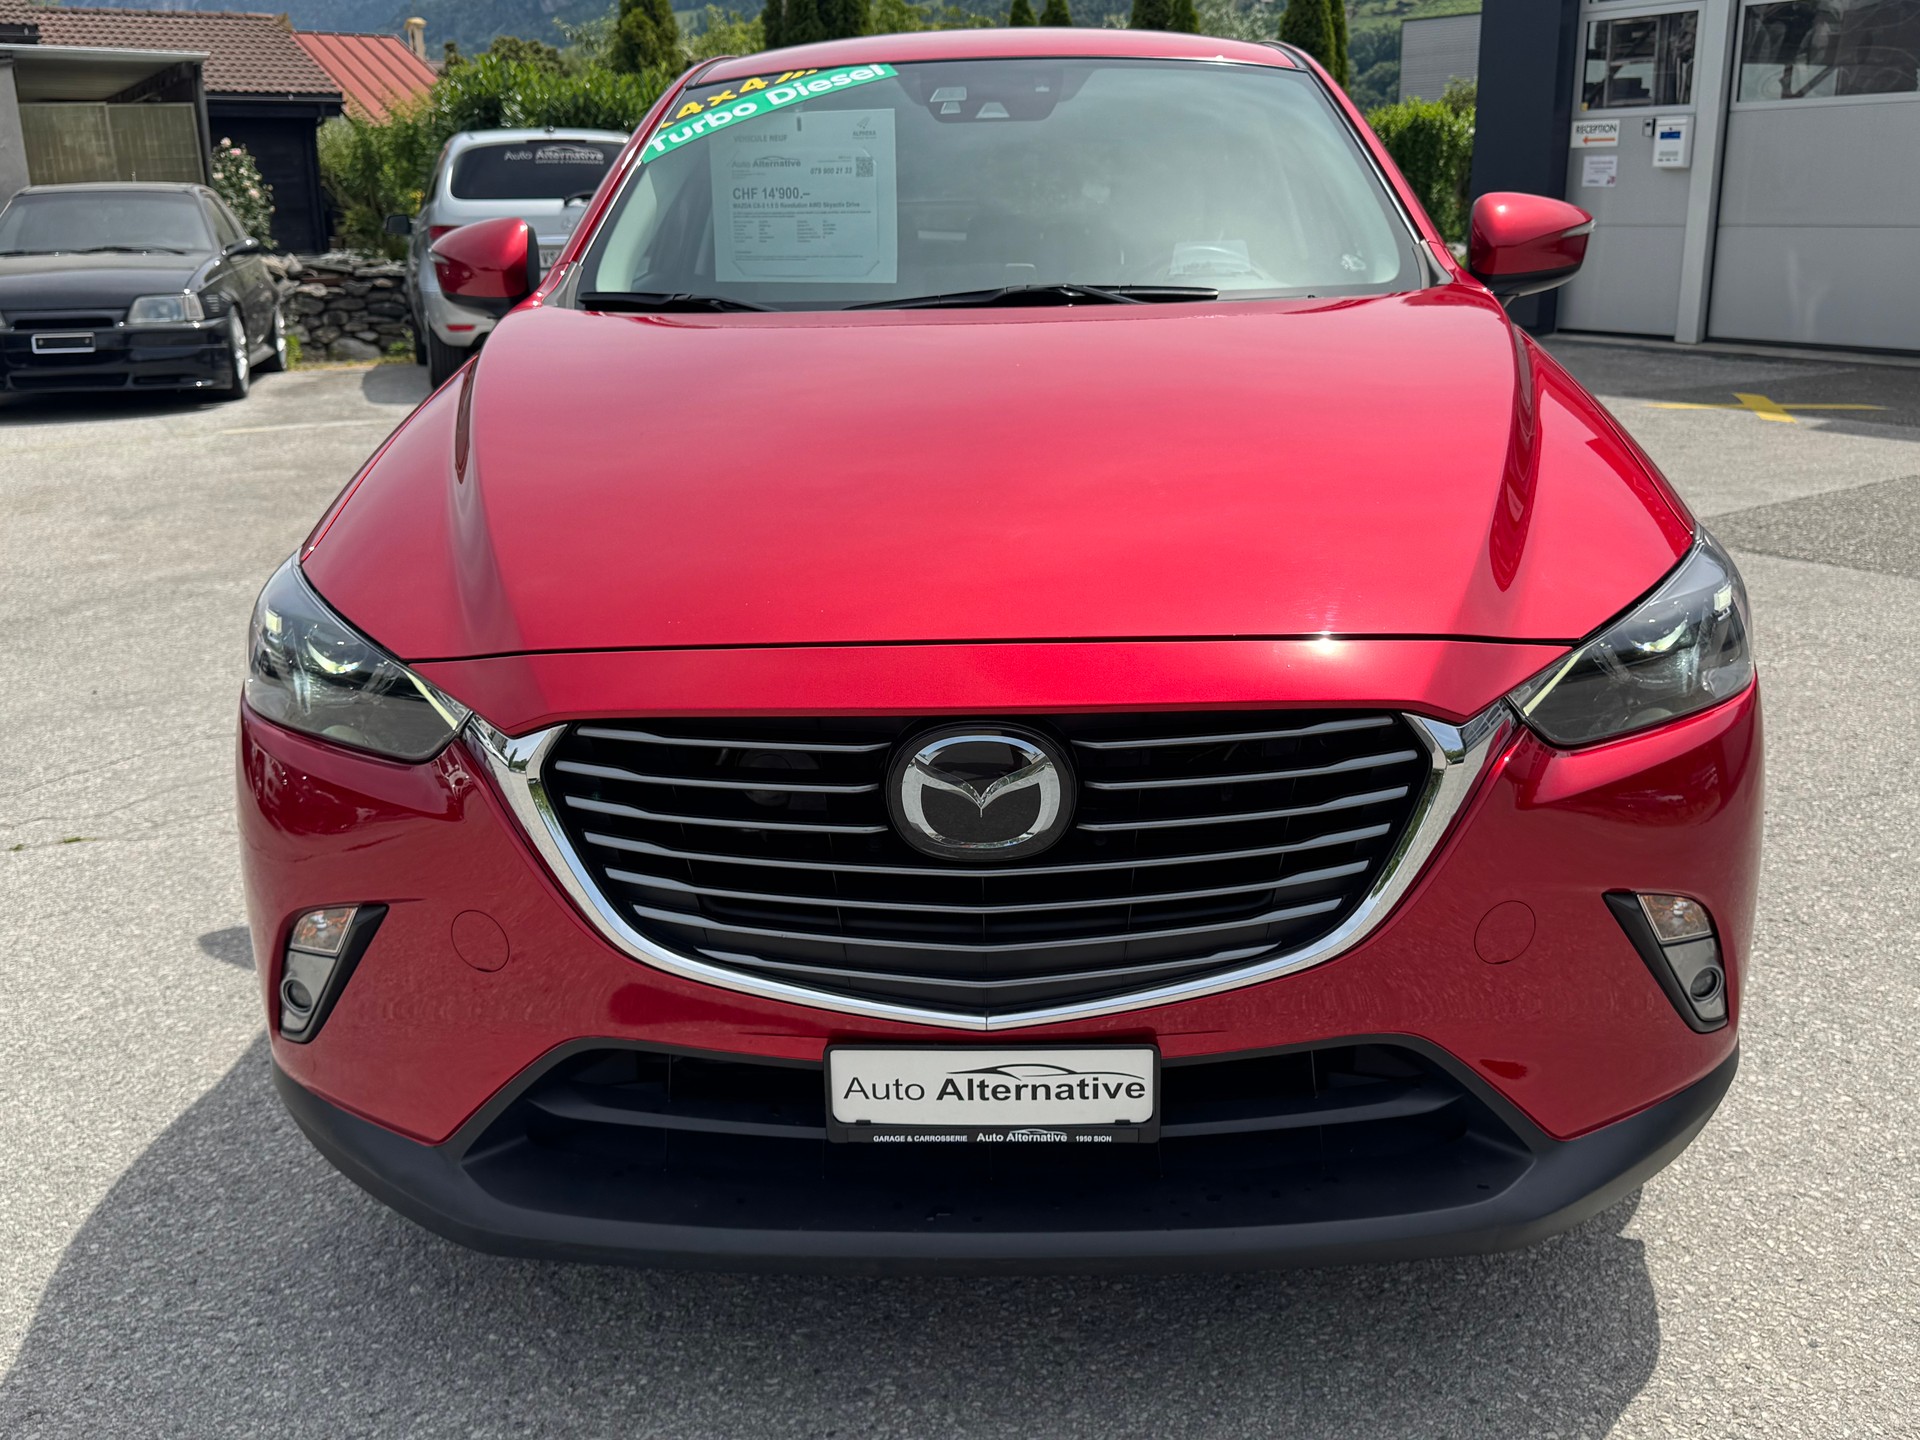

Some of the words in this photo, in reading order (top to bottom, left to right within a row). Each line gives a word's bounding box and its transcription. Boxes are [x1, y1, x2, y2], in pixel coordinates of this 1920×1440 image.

[649, 102, 758, 152] Turbo
[764, 64, 886, 106] Diesel
[1576, 124, 1617, 134] RECEPTION
[504, 151, 533, 161] Auto
[535, 149, 604, 161] Alternative
[731, 160, 751, 168] Auto
[752, 159, 802, 168] Alternative
[733, 187, 758, 200] CHF
[843, 1077, 926, 1101] Auto
[935, 1076, 1146, 1101] Alternative
[873, 1135, 905, 1143] GARAGE
[976, 1133, 1004, 1142] Auto
[1006, 1132, 1068, 1142] Alternative
